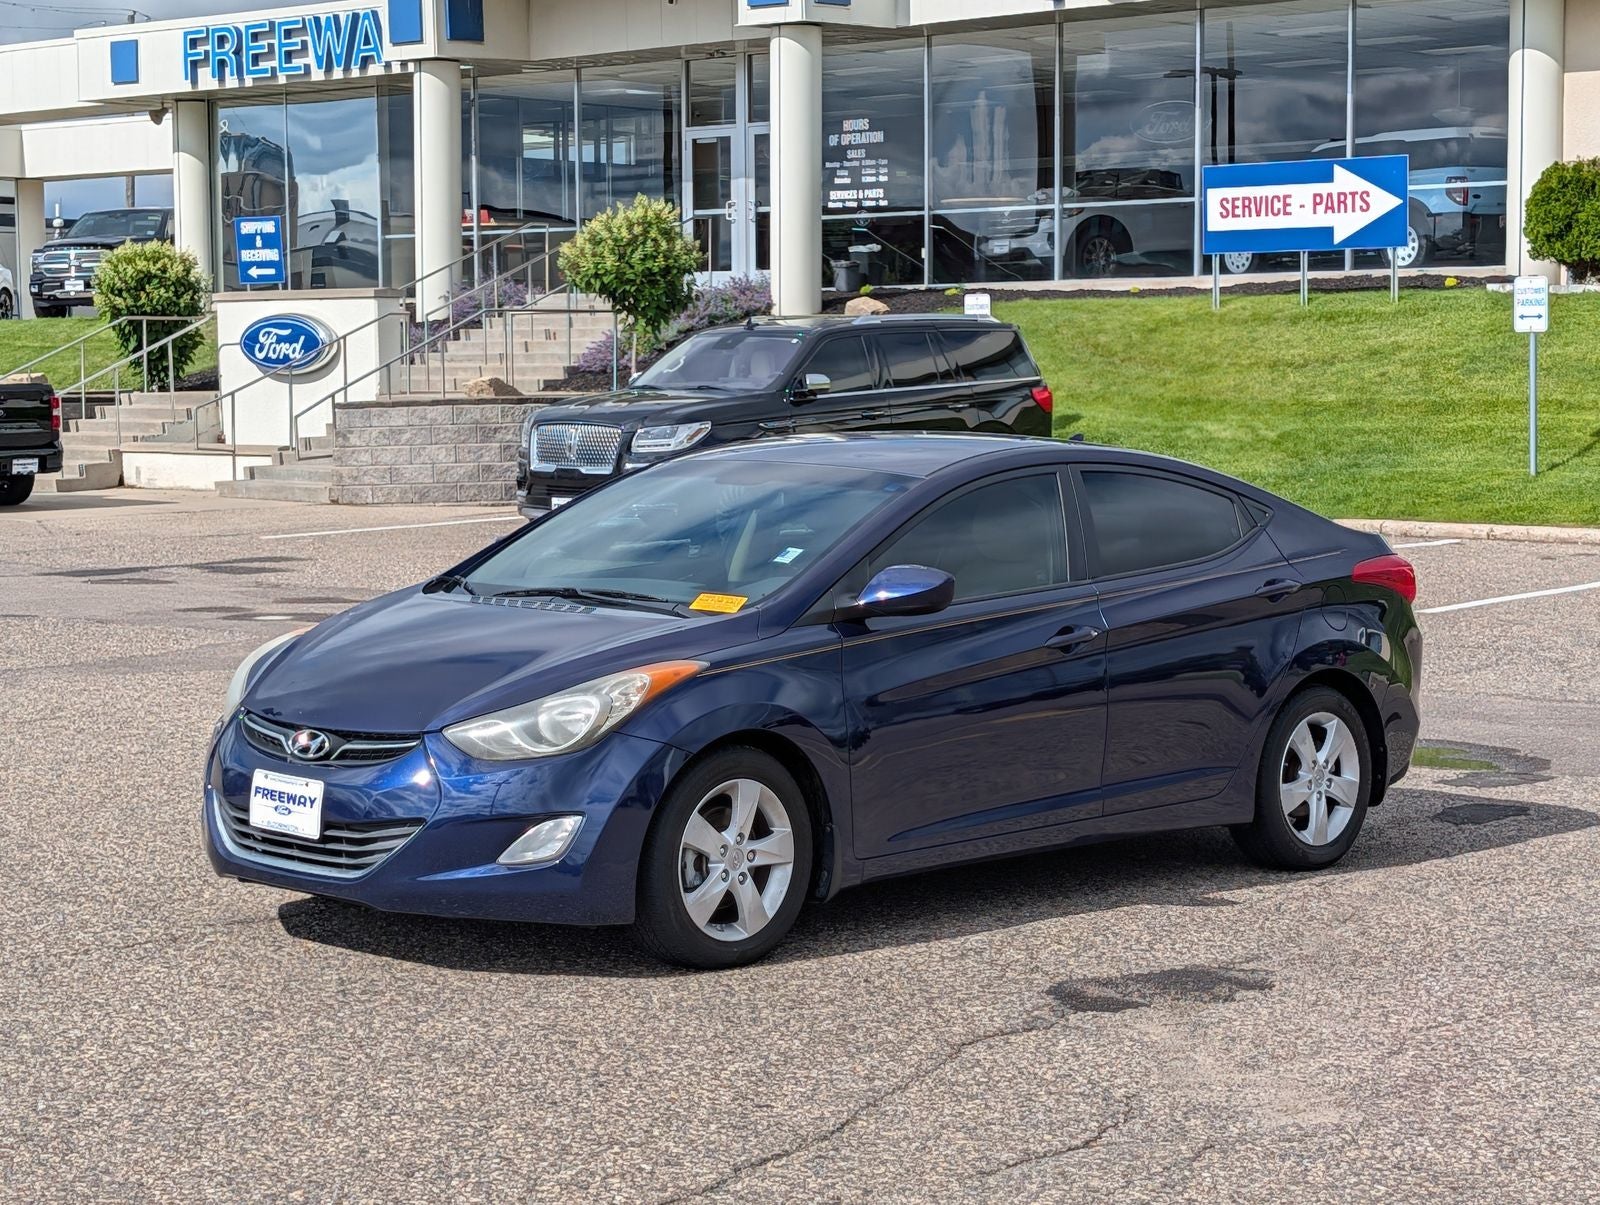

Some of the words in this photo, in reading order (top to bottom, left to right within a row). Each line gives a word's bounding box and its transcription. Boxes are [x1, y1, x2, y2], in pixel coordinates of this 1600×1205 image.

[183, 9, 385, 82] FREEWA
[842, 118, 870, 132] HOURS
[828, 134, 839, 147] OF
[840, 130, 884, 146] OPERATION
[846, 148, 866, 159] SALES
[864, 188, 884, 199] PARTS
[1219, 194, 1292, 219] SERVICE
[1312, 190, 1371, 215] PARTS
[240, 220, 276, 235] SHIPPING
[255, 234, 263, 248] &
[241, 248, 280, 262] RECEIVING
[1516, 287, 1545, 295] CUSTOMER
[1516, 298, 1545, 307] PARKING
[254, 327, 306, 361] Ford
[253, 785, 318, 809] FREEWAY
